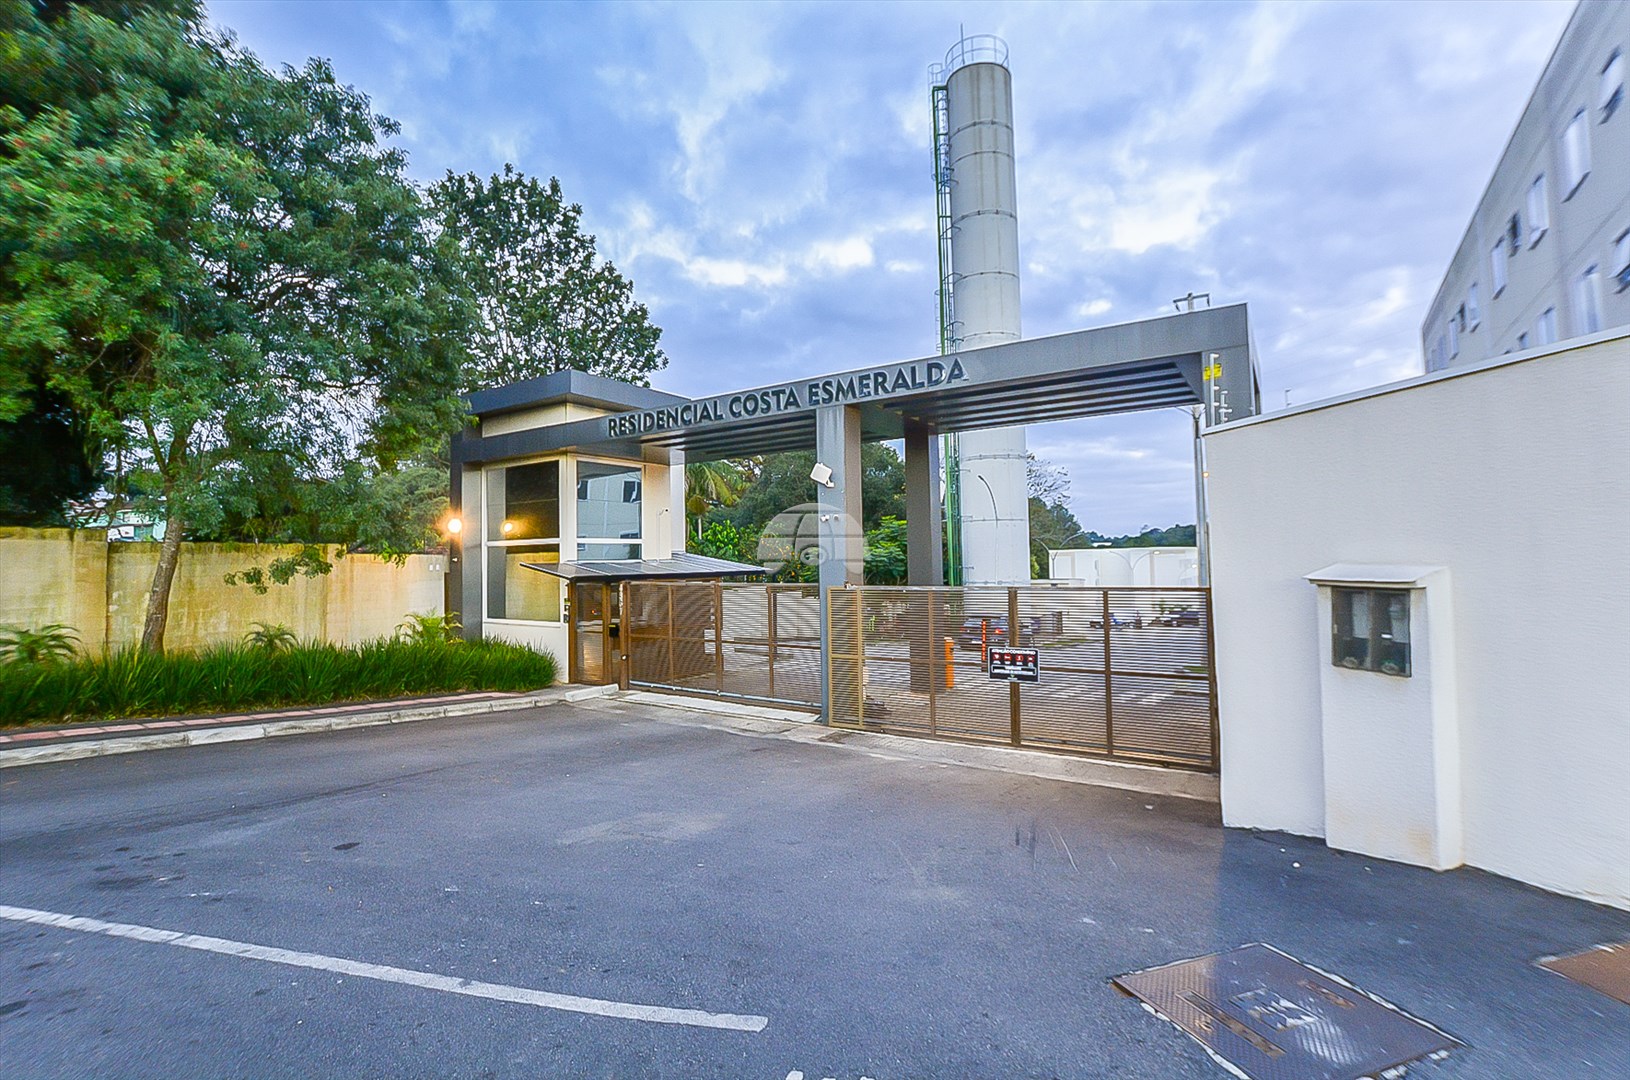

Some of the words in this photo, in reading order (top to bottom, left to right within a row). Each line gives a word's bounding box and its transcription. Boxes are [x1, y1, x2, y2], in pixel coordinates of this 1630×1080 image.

[608, 400, 724, 437] RESIDENCIAL
[728, 387, 801, 418] COSTA
[808, 358, 968, 406] ESMERALDA
